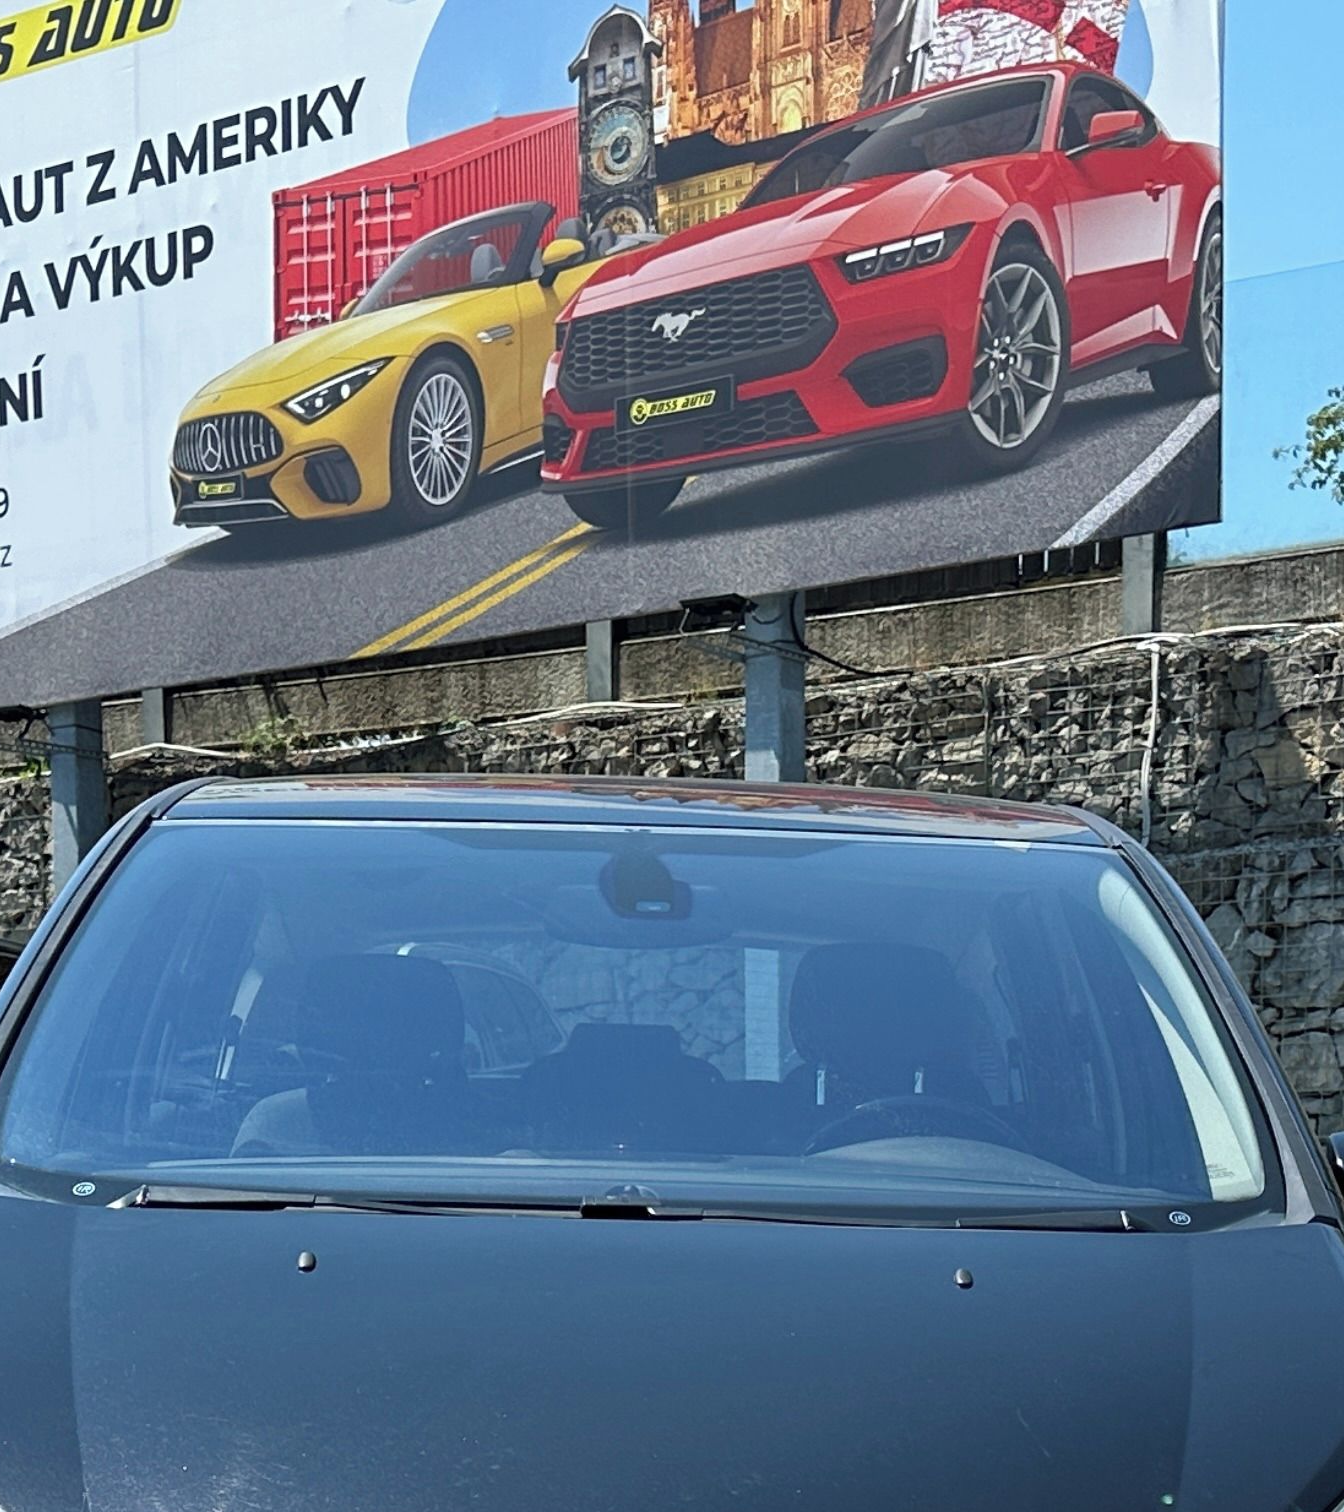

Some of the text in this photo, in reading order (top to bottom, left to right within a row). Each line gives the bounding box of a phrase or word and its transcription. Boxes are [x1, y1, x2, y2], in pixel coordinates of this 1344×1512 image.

[86, 149, 116, 206] Z
[128, 77, 366, 195] AMERIKY
[0, 271, 35, 323] A
[45, 223, 215, 310] VÝKUP
